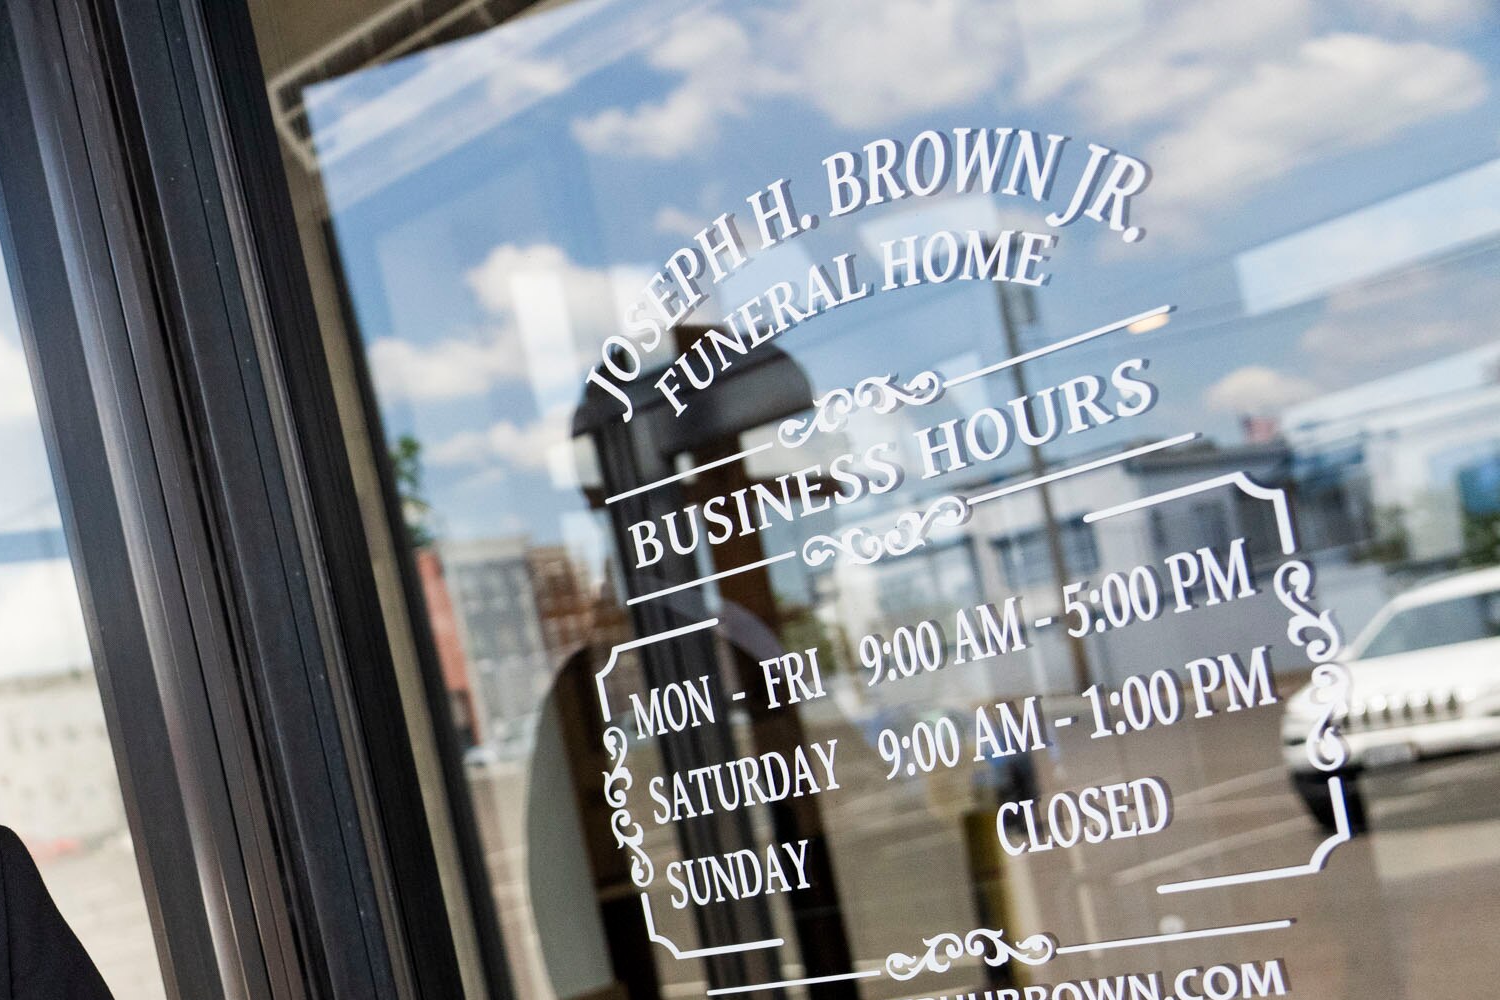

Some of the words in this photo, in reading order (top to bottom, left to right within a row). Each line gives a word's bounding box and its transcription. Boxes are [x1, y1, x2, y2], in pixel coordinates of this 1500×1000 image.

[585, 213, 750, 424] JOSEPH
[747, 178, 815, 248] H.
[822, 127, 1070, 218] BROWN
[1047, 144, 1150, 243] JR.
[654, 253, 869, 419] FUNERAL
[881, 229, 1059, 291] HOME
[628, 441, 903, 569] BUSINESS
[914, 358, 1155, 480] HOURS
[629, 675, 716, 741] MON
[731, 691, 747, 702] -
[759, 647, 827, 711] FRI
[859, 620, 942, 687] 9:00
[952, 597, 1027, 667] AM
[1035, 617, 1052, 628] -
[1065, 570, 1159, 640] 5:00
[1164, 538, 1255, 614] PM
[648, 739, 842, 826] SATURDAY
[877, 713, 960, 780] 9:00
[972, 695, 1047, 762] AM
[1055, 716, 1072, 727] -
[1085, 674, 1180, 740] 1:00
[1184, 647, 1277, 719] PM
[665, 840, 812, 911] SUNDAY
[995, 777, 1169, 856] CLOSED
